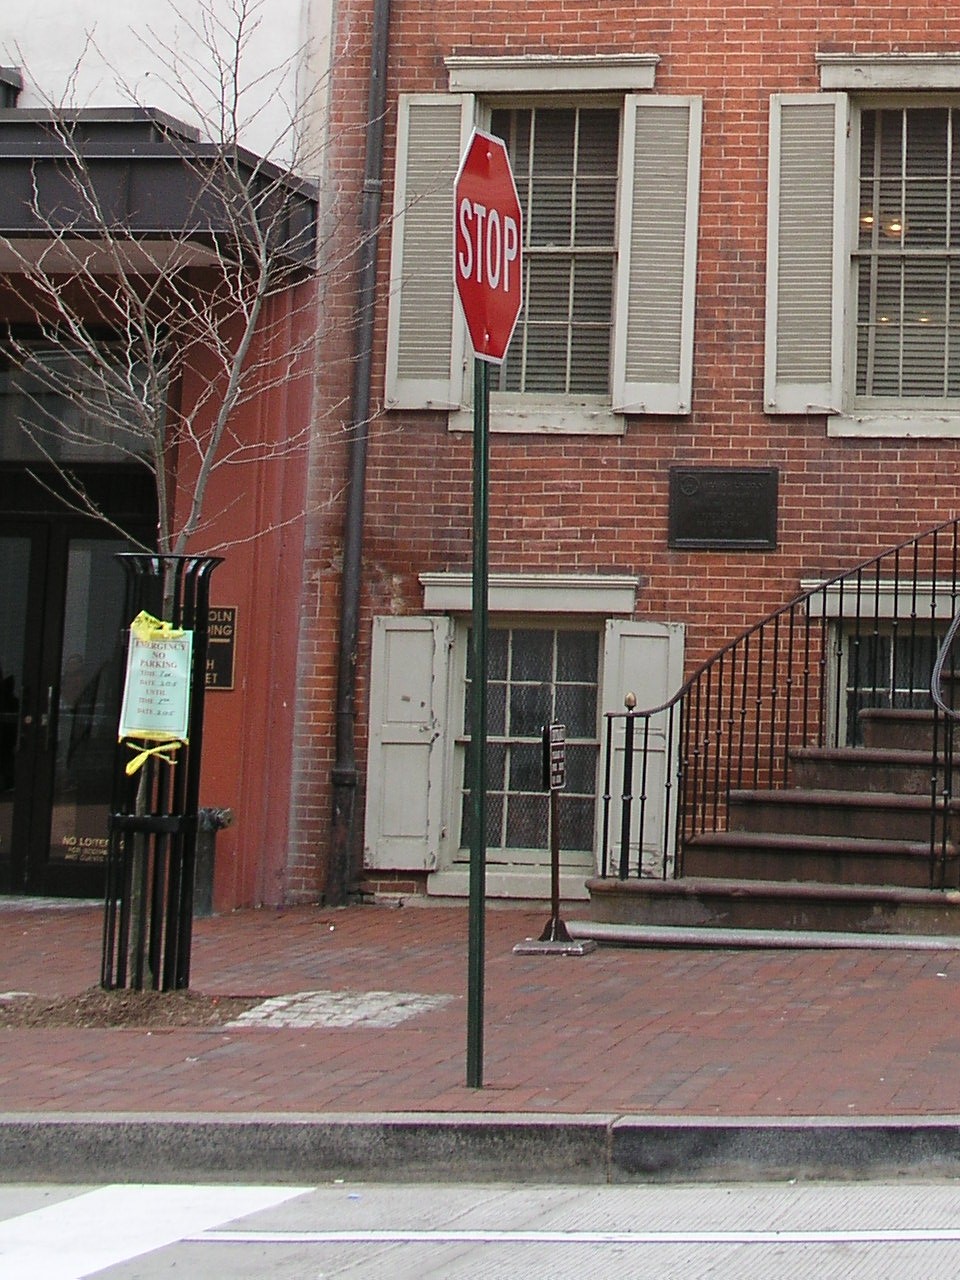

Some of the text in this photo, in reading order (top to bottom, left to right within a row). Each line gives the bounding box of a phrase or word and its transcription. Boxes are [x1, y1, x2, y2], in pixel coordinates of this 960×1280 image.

[458, 197, 518, 293] STOP
[152, 651, 166, 659] NO
[140, 660, 178, 669] PARKING
[62, 836, 77, 846] NO
